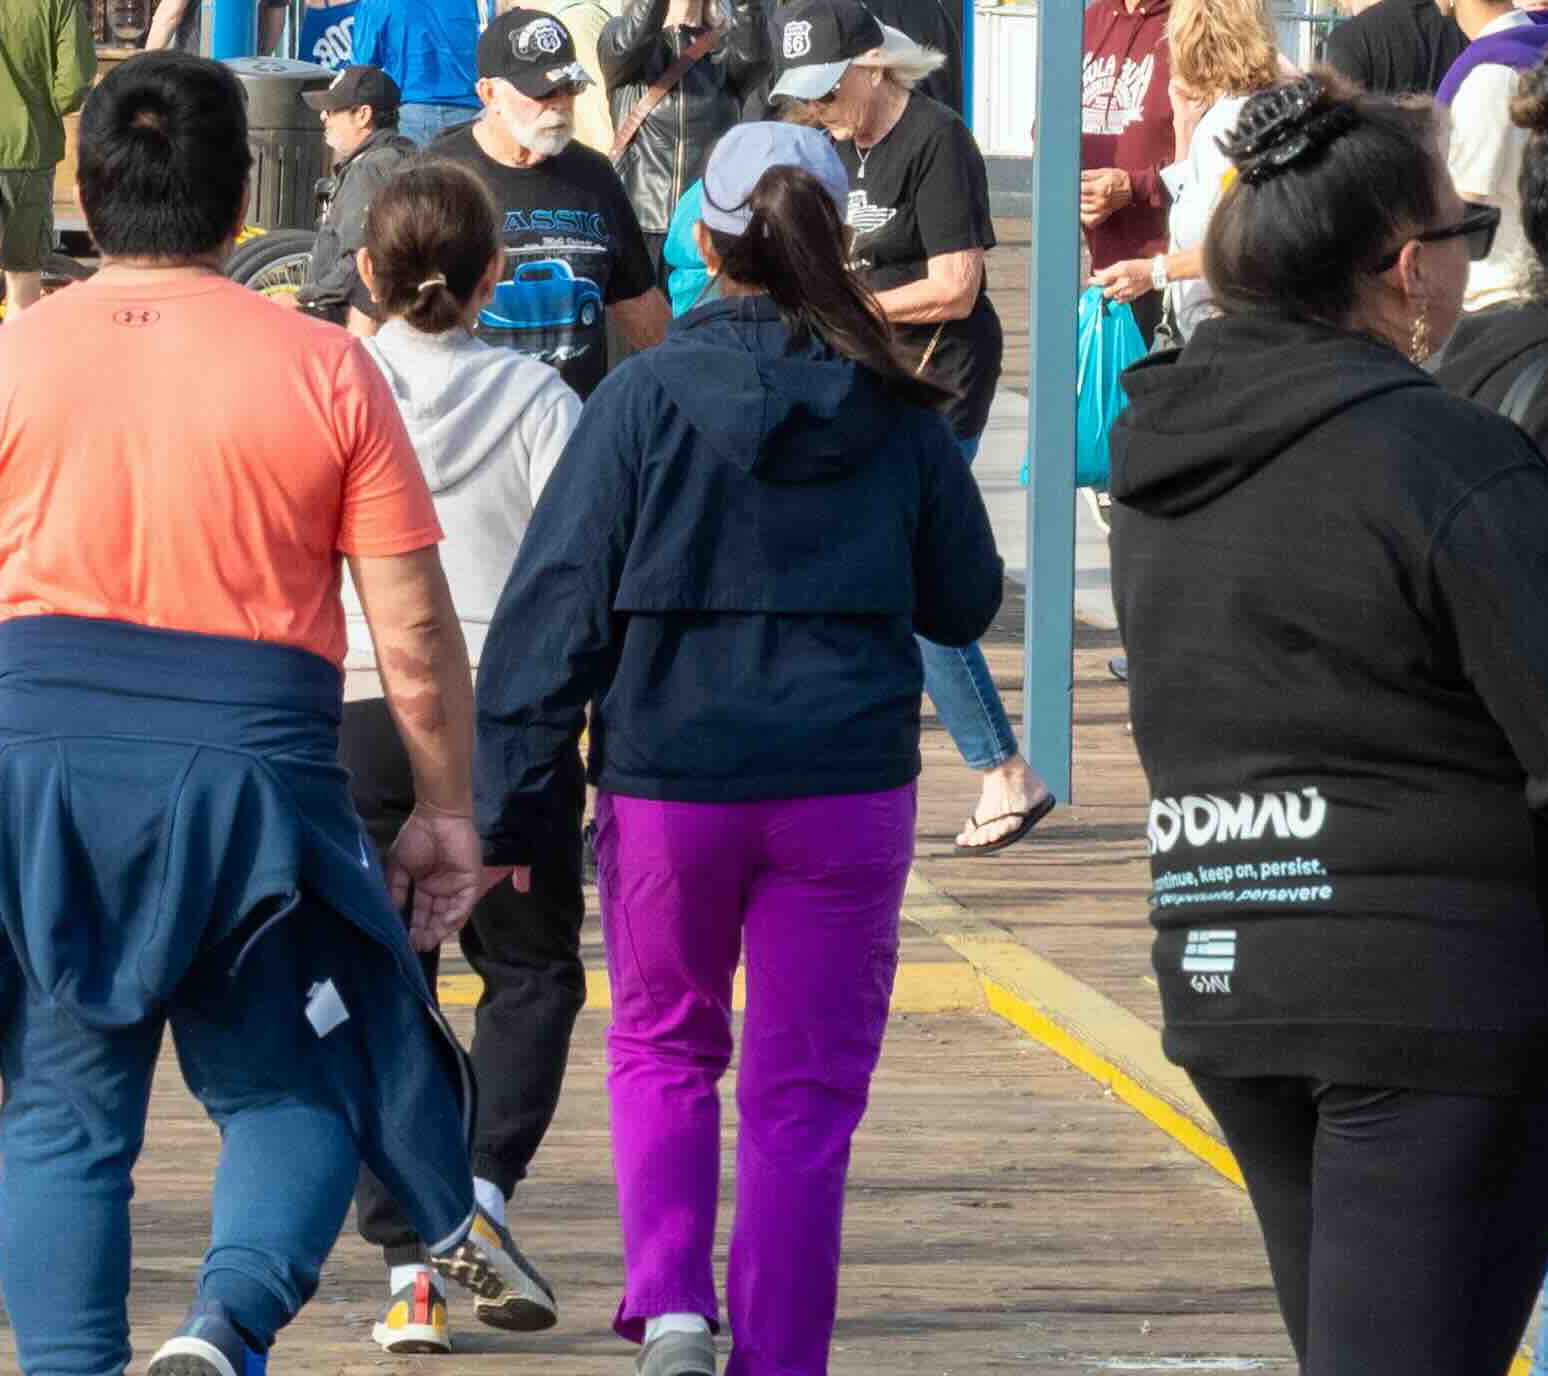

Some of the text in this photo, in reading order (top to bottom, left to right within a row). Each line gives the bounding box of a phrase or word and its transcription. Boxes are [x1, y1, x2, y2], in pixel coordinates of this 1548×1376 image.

[1155, 856, 1327, 891] ontinue, keep on, persist.
